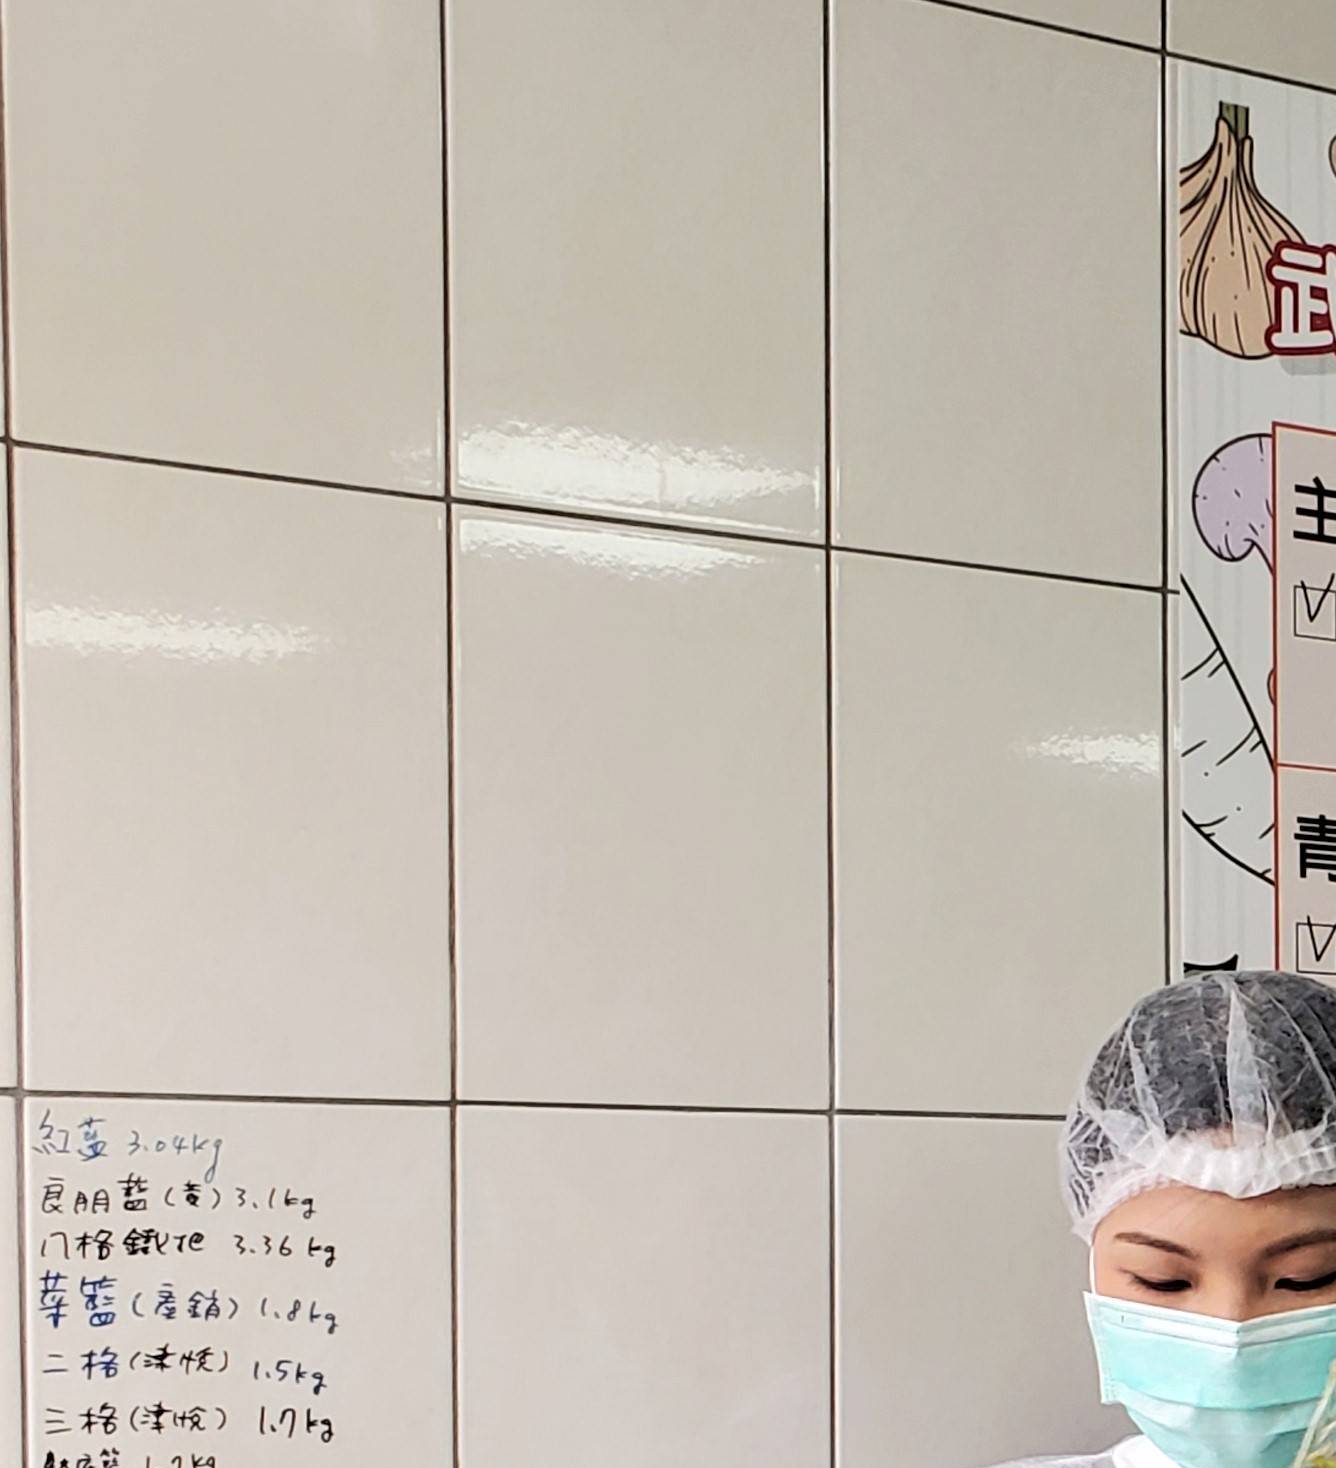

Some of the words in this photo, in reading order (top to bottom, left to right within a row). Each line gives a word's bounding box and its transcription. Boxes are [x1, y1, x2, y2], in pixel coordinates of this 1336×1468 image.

[128, 1131, 222, 1183] 3.04kg
[236, 1187, 317, 1219] 3.1kg
[253, 1360, 328, 1395] 1.5kg
